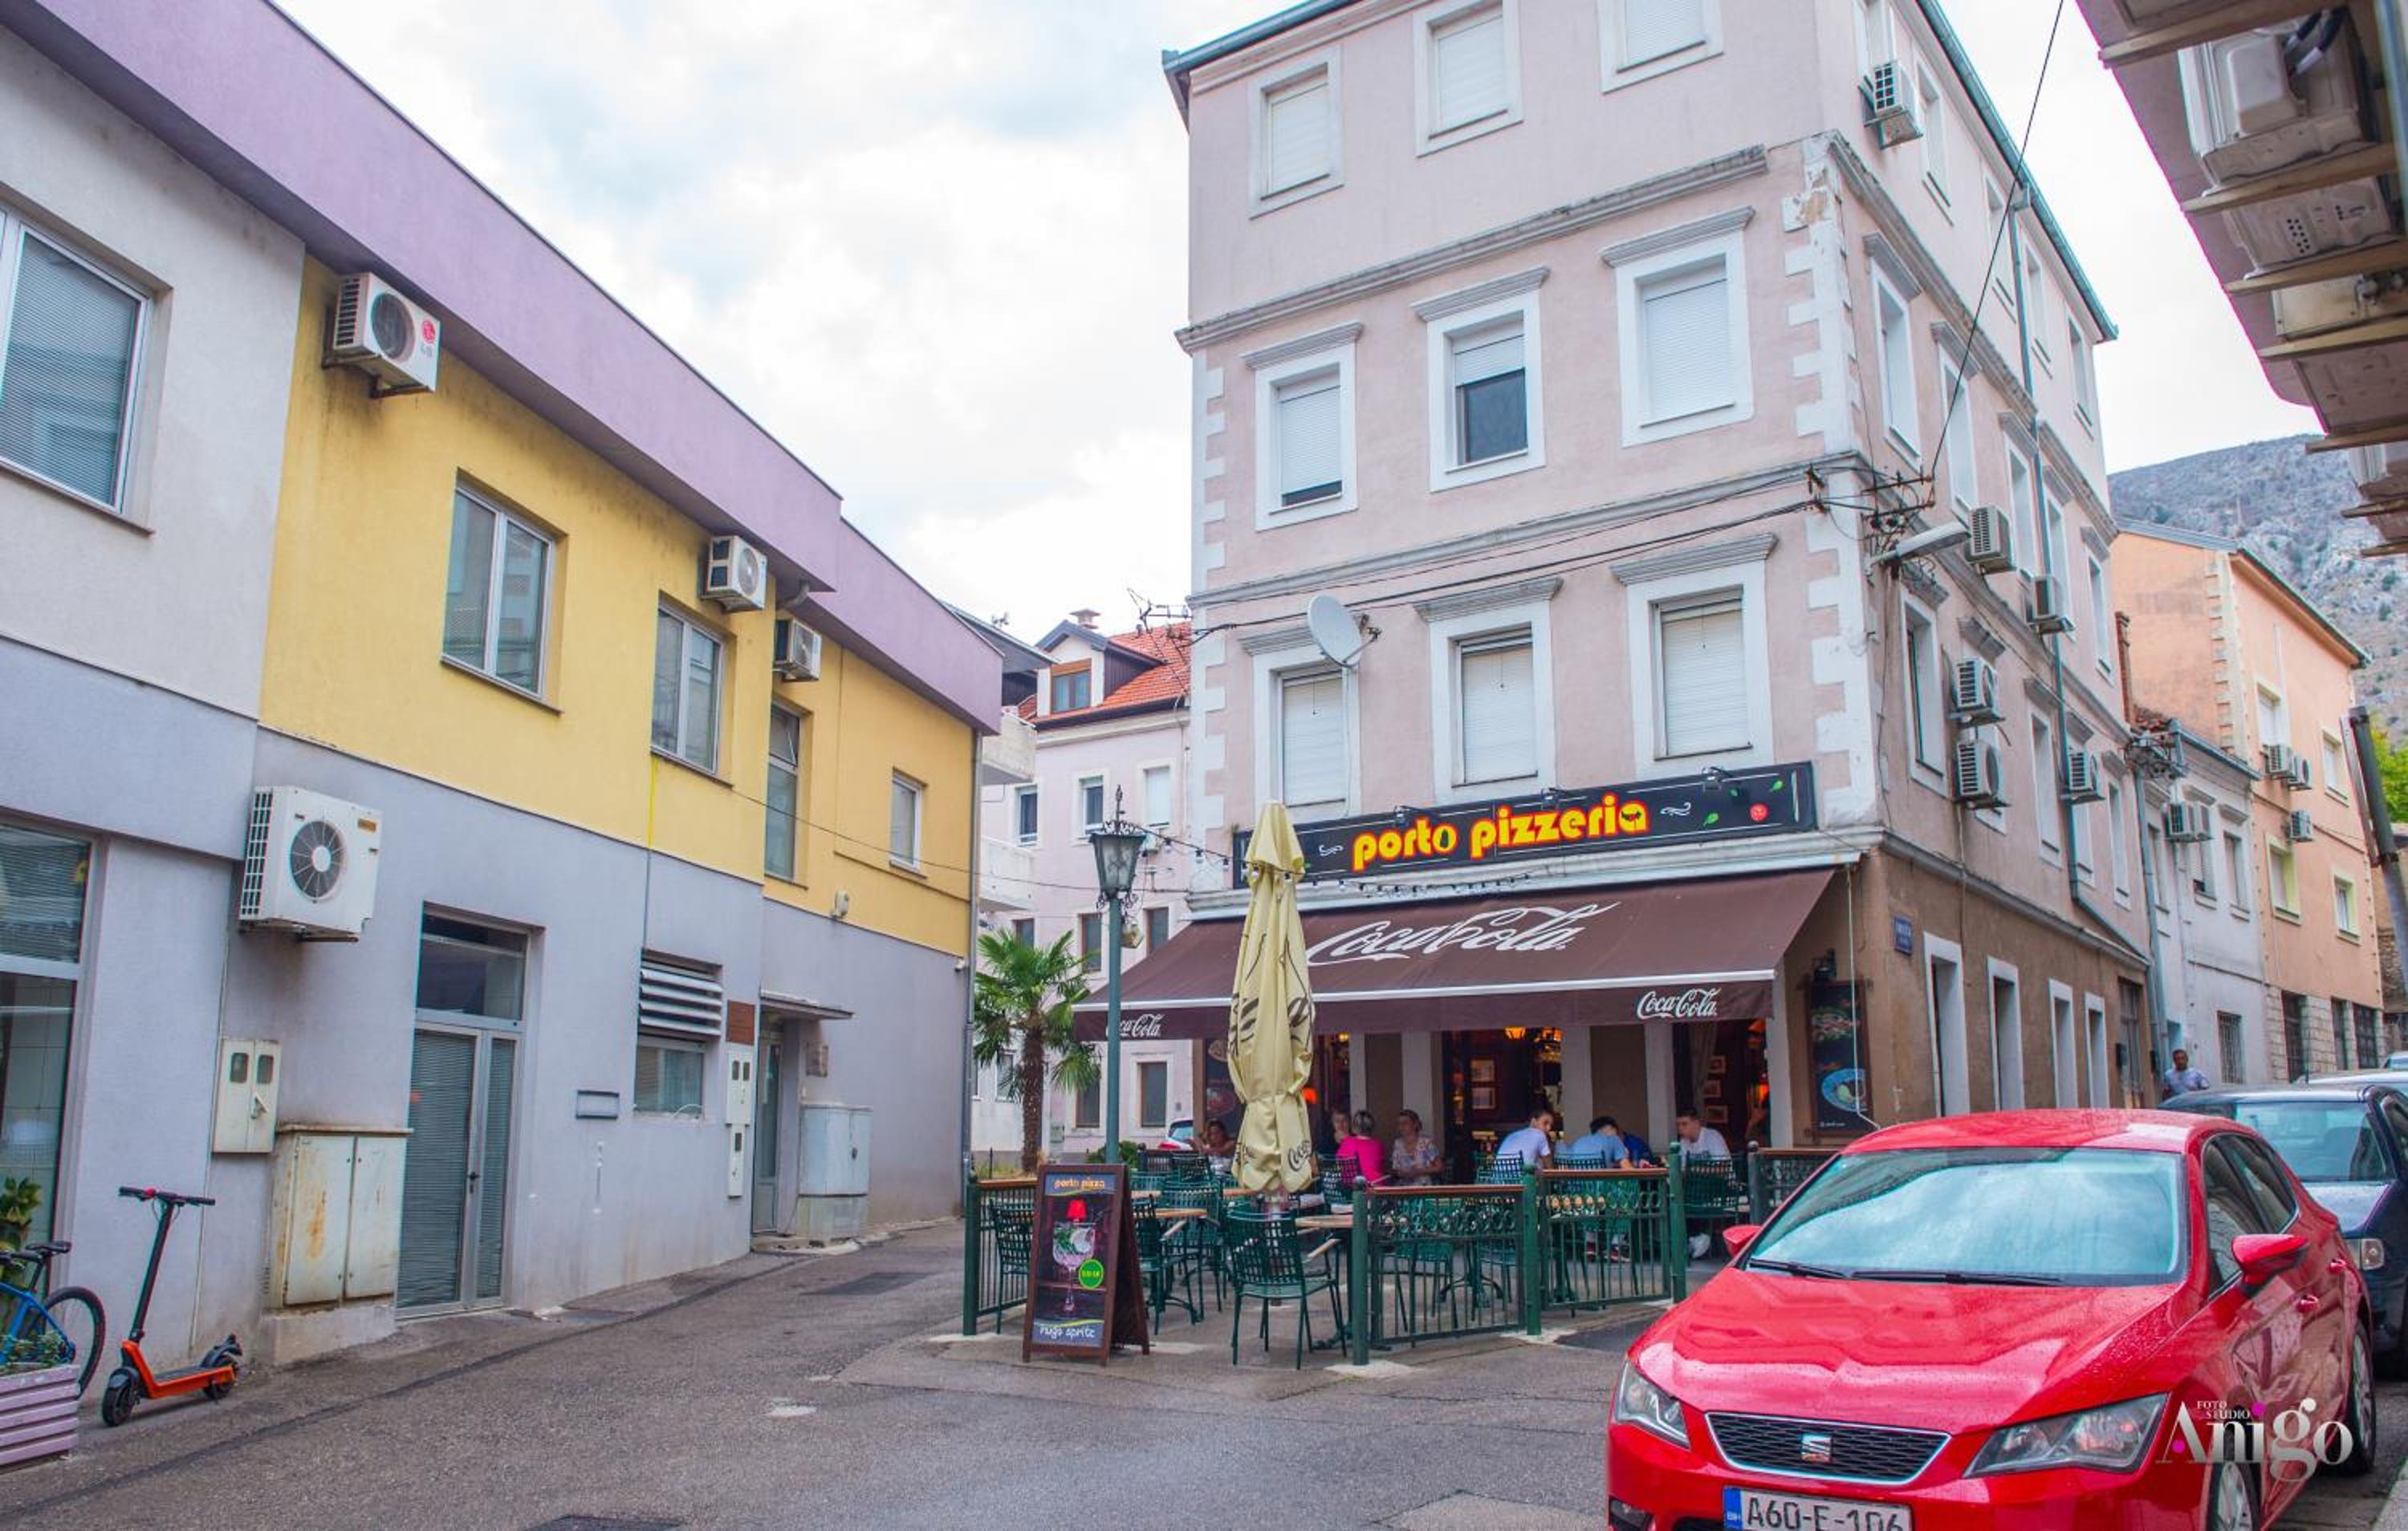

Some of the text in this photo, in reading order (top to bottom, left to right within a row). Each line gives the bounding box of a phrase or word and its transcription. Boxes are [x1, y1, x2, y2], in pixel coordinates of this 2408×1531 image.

[1352, 791, 1649, 873] porto pizzeria
[1637, 988, 1721, 1020] Coca-Cola
[1747, 1497, 1904, 1531] A60-E-106
